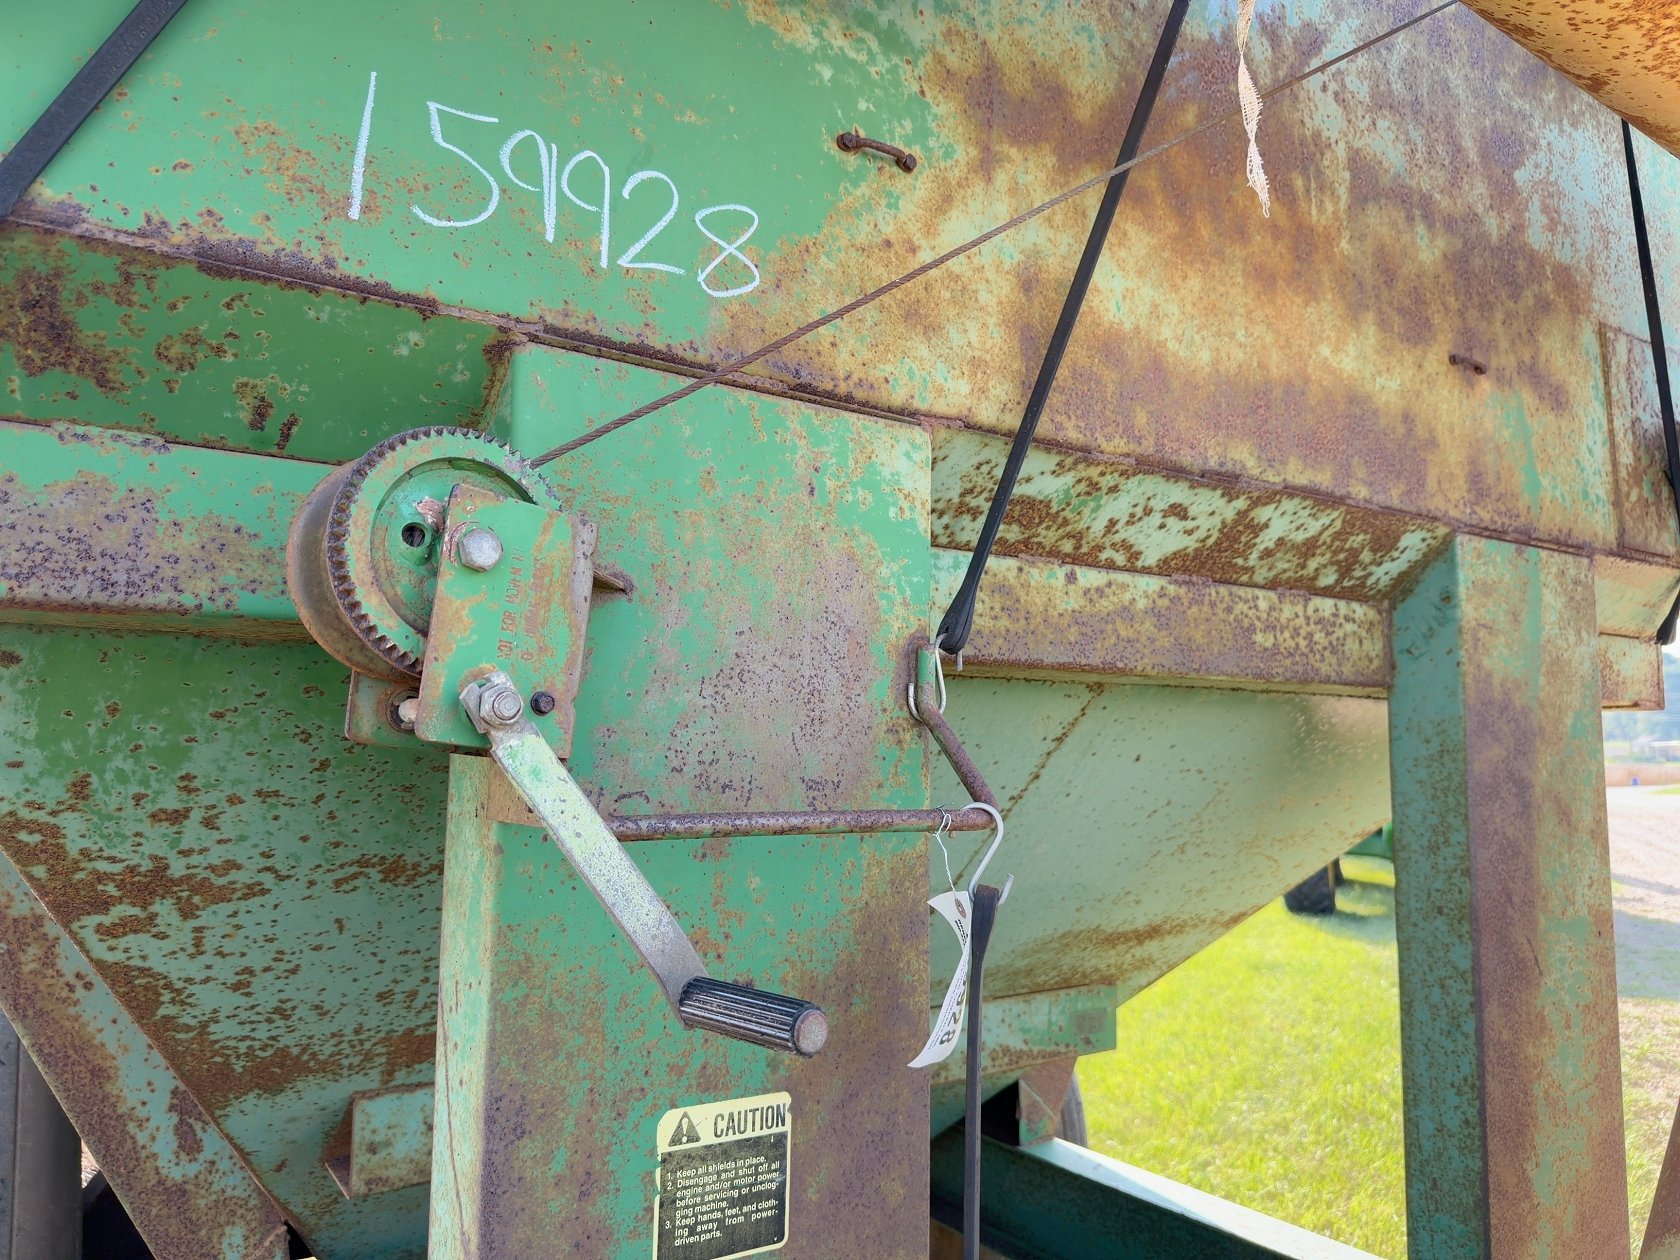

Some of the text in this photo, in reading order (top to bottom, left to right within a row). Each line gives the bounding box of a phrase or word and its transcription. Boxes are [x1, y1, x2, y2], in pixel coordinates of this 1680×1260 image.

[349, 71, 761, 298] 159928
[501, 610, 517, 633] FOR
[713, 1103, 787, 1138] CAUTION
[667, 1155, 767, 1180] 1. Keep all shields in place.
[667, 1160, 780, 1190] 2. Disengage and shut off all
[676, 1170, 780, 1198] engine and/or motor power
[676, 1181, 779, 1208] before servicing or unclog-
[665, 1220, 673, 1230] 3.
[675, 1216, 696, 1227] Keep
[724, 1206, 741, 1217] feet,
[742, 1201, 757, 1213] and
[757, 1198, 779, 1210] cloth-
[675, 1200, 729, 1219] ging machine.
[675, 1208, 779, 1237] ing away from power-
[674, 1229, 723, 1247] driven parts.
